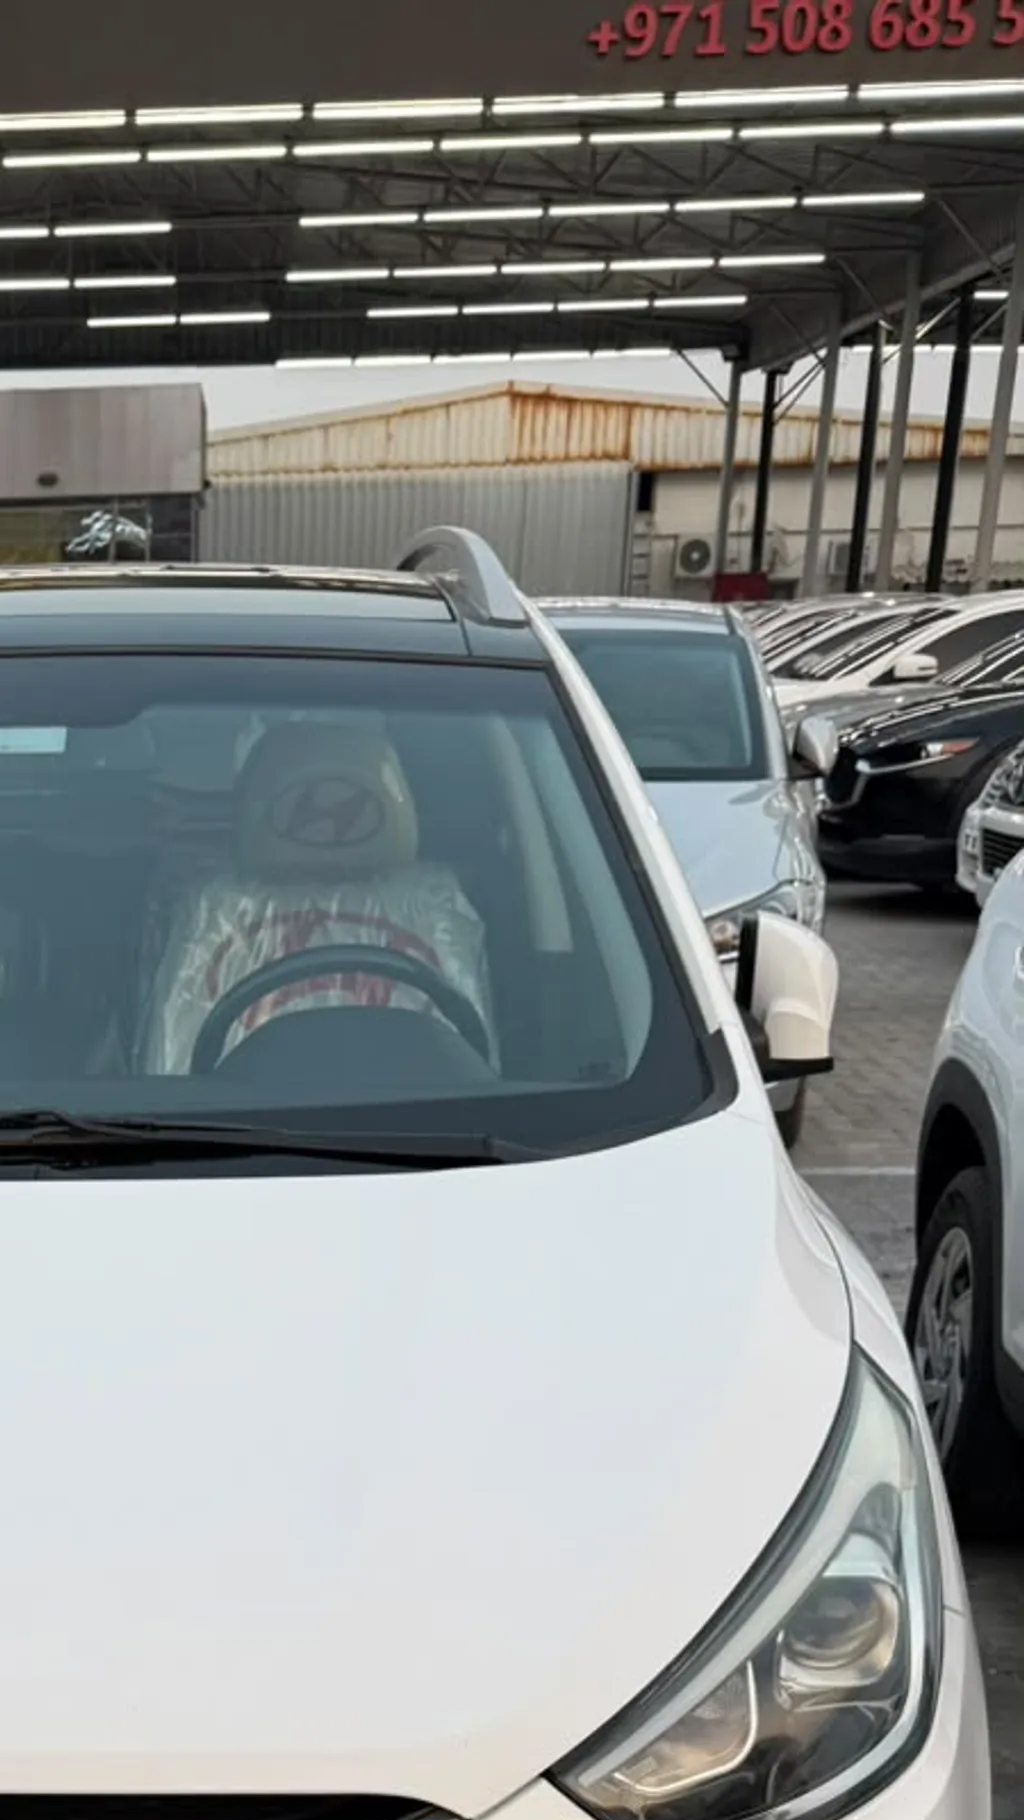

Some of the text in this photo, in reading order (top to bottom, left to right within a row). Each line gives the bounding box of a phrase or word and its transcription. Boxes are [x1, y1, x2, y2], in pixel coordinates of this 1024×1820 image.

[587, 3, 727, 58] +971
[745, 0, 854, 54] 508
[869, 0, 976, 50] 685
